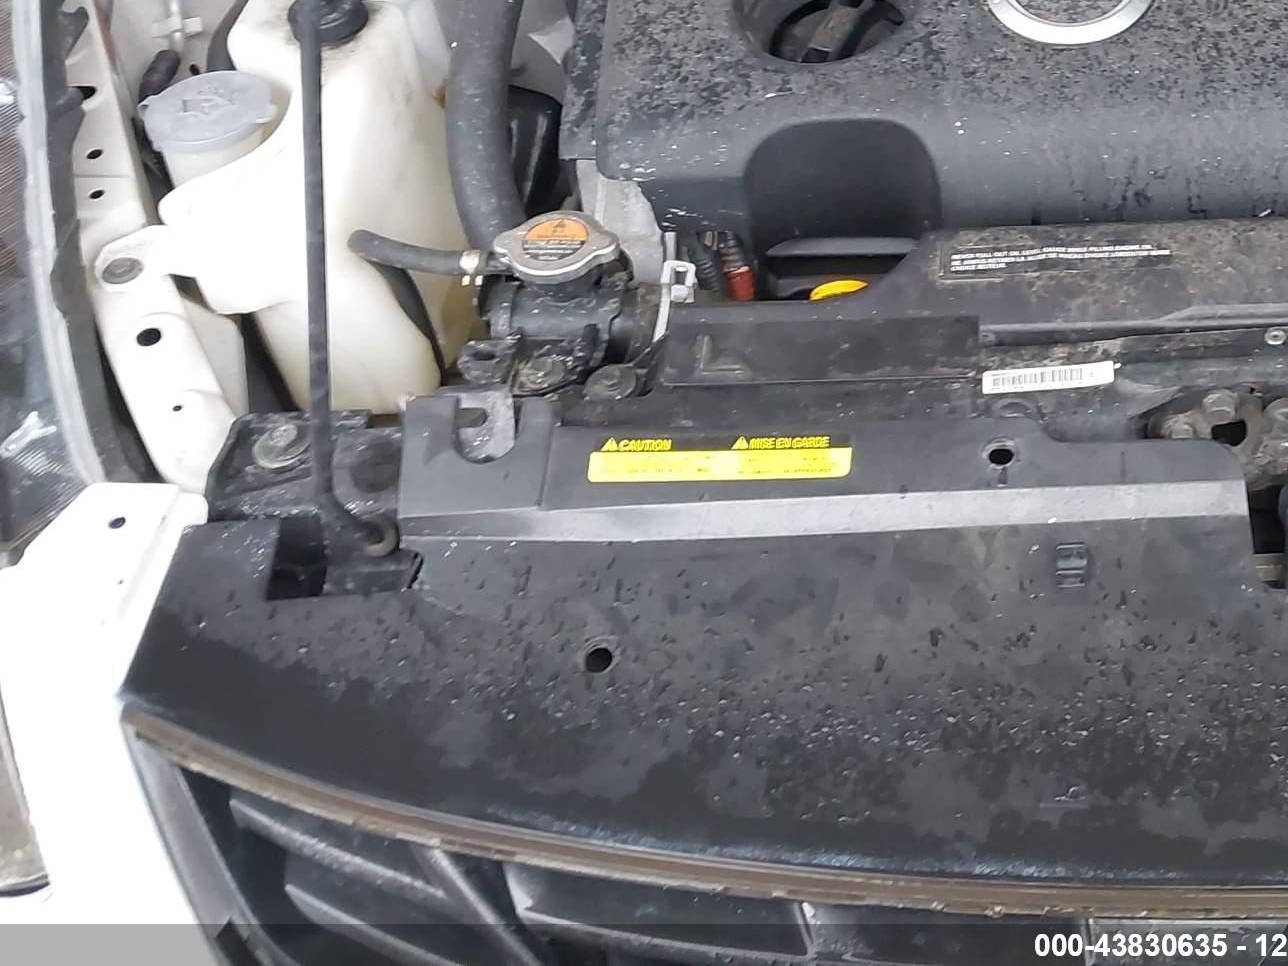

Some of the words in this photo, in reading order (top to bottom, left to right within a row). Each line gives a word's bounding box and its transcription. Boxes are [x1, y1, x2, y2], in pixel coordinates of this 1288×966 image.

[618, 438, 673, 452] CAUTION
[749, 437, 775, 450] MISE
[775, 437, 792, 450] EN
[792, 436, 830, 449] GARDE
